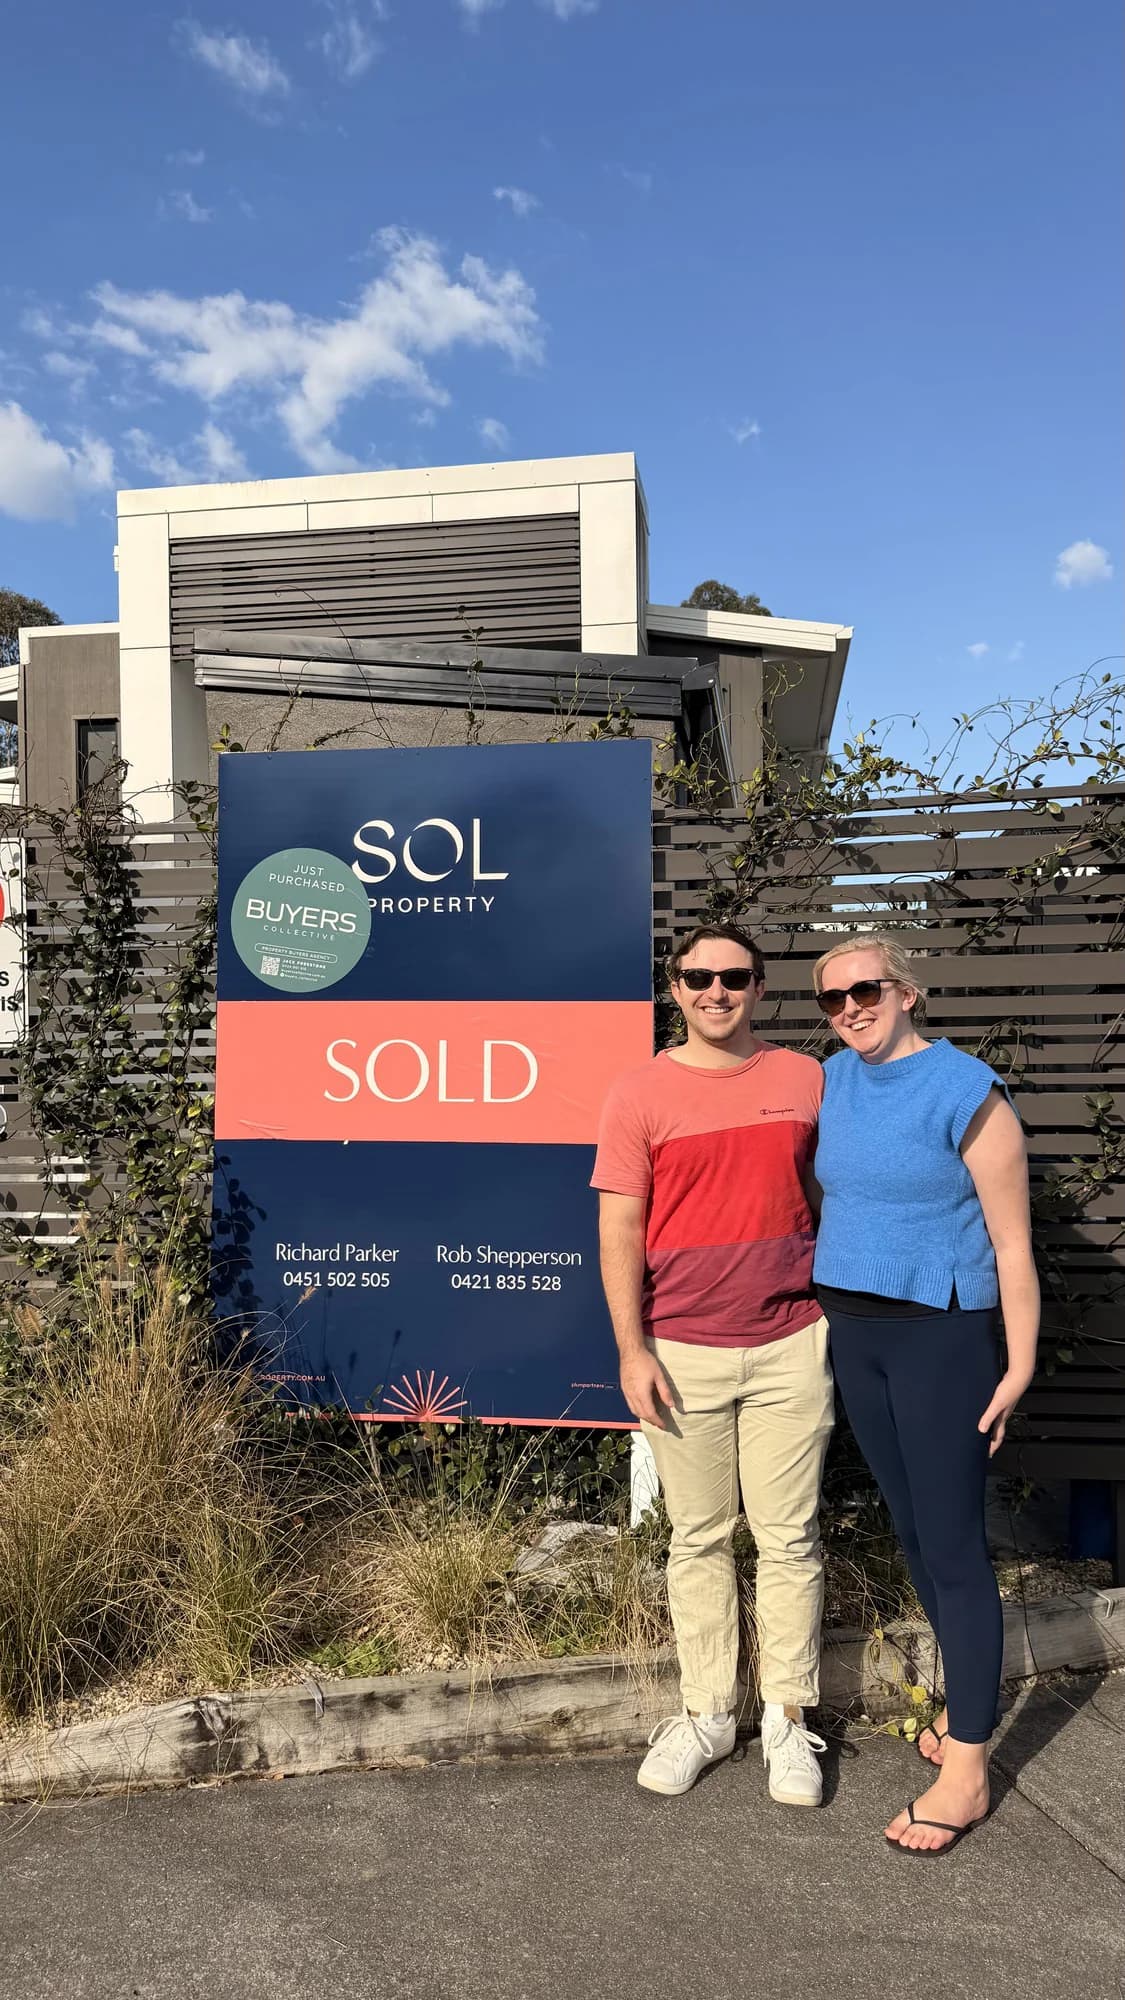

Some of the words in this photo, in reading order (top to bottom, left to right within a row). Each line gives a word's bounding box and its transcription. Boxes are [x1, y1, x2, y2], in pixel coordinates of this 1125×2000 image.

[351, 818, 509, 883] SOL
[293, 864, 325, 876] JUST
[269, 873, 345, 892] PURCHASED
[246, 898, 357, 933] BUYERS
[263, 924, 336, 941] COLLECTIVE
[323, 1038, 539, 1103] SOLD
[275, 1242, 340, 1261] Richard
[345, 1243, 400, 1262] Parker
[436, 1244, 472, 1263] Rob
[476, 1244, 583, 1269] Shepperson
[283, 1271, 322, 1287] 0451
[327, 1272, 356, 1288] 502
[360, 1272, 391, 1288] 505
[451, 1274, 492, 1289] 0421
[496, 1274, 527, 1290] 835
[531, 1275, 562, 1291] 528
